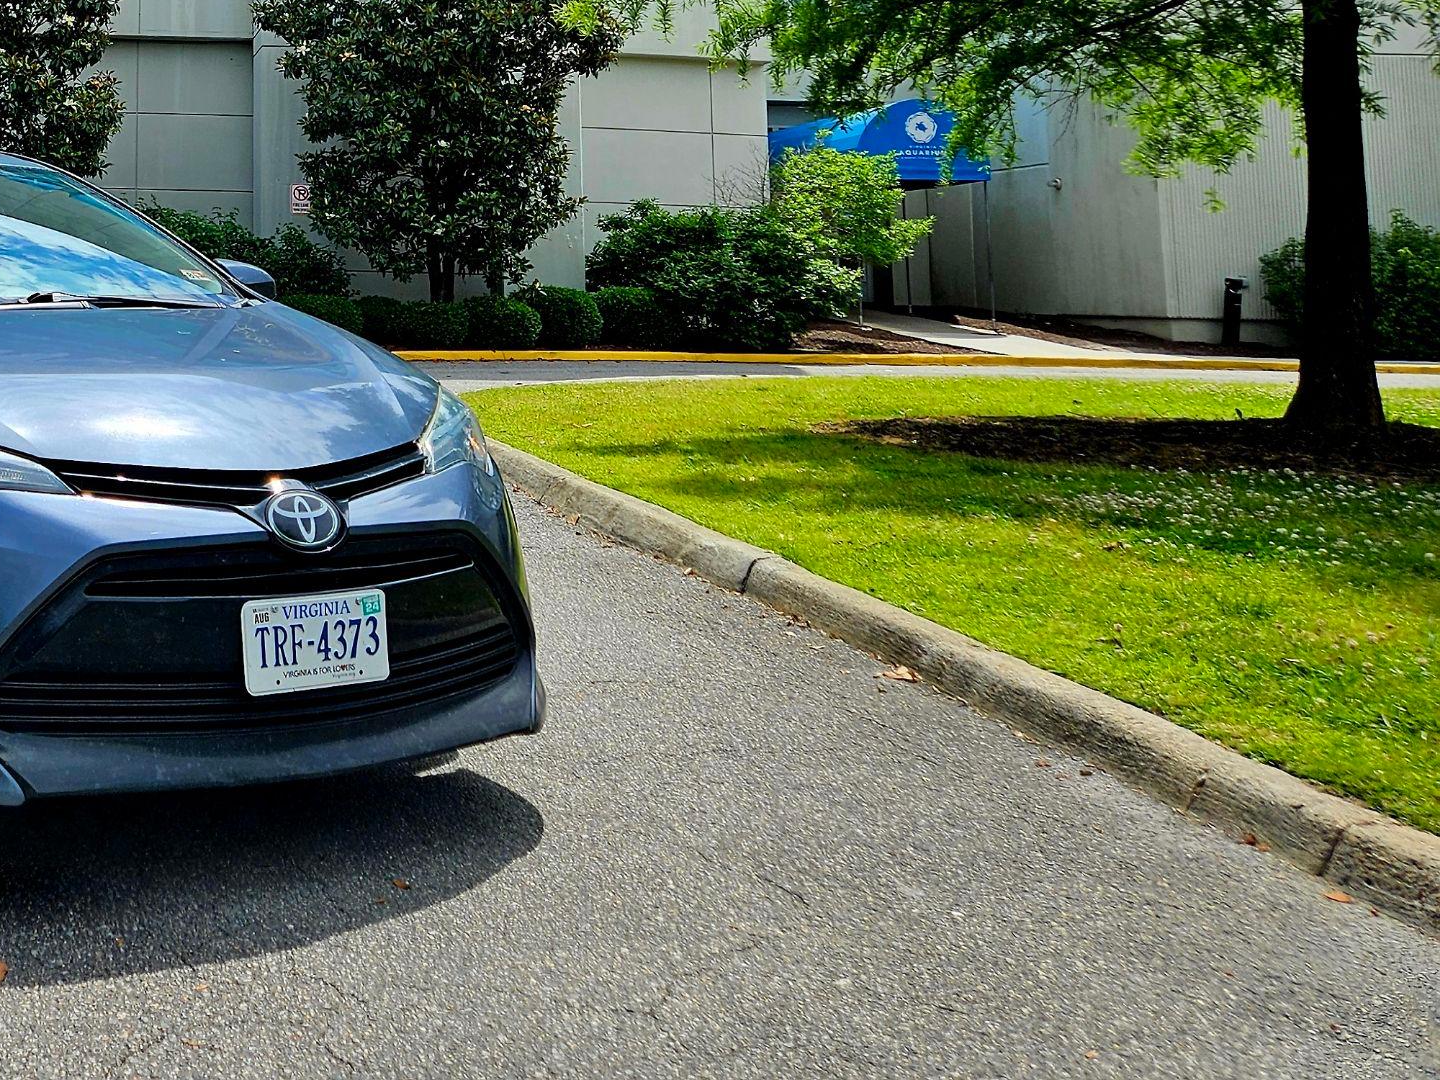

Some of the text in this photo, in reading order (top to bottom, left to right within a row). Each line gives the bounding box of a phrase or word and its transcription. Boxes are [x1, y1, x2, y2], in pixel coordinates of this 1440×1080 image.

[282, 600, 350, 619] VIRGINIA
[365, 601, 379, 613] 24
[254, 612, 269, 624] AUG
[254, 616, 380, 669] TRF-4373
[283, 668, 312, 679] VIRGINIA
[312, 667, 318, 675] IS
[319, 665, 332, 675] FOR
